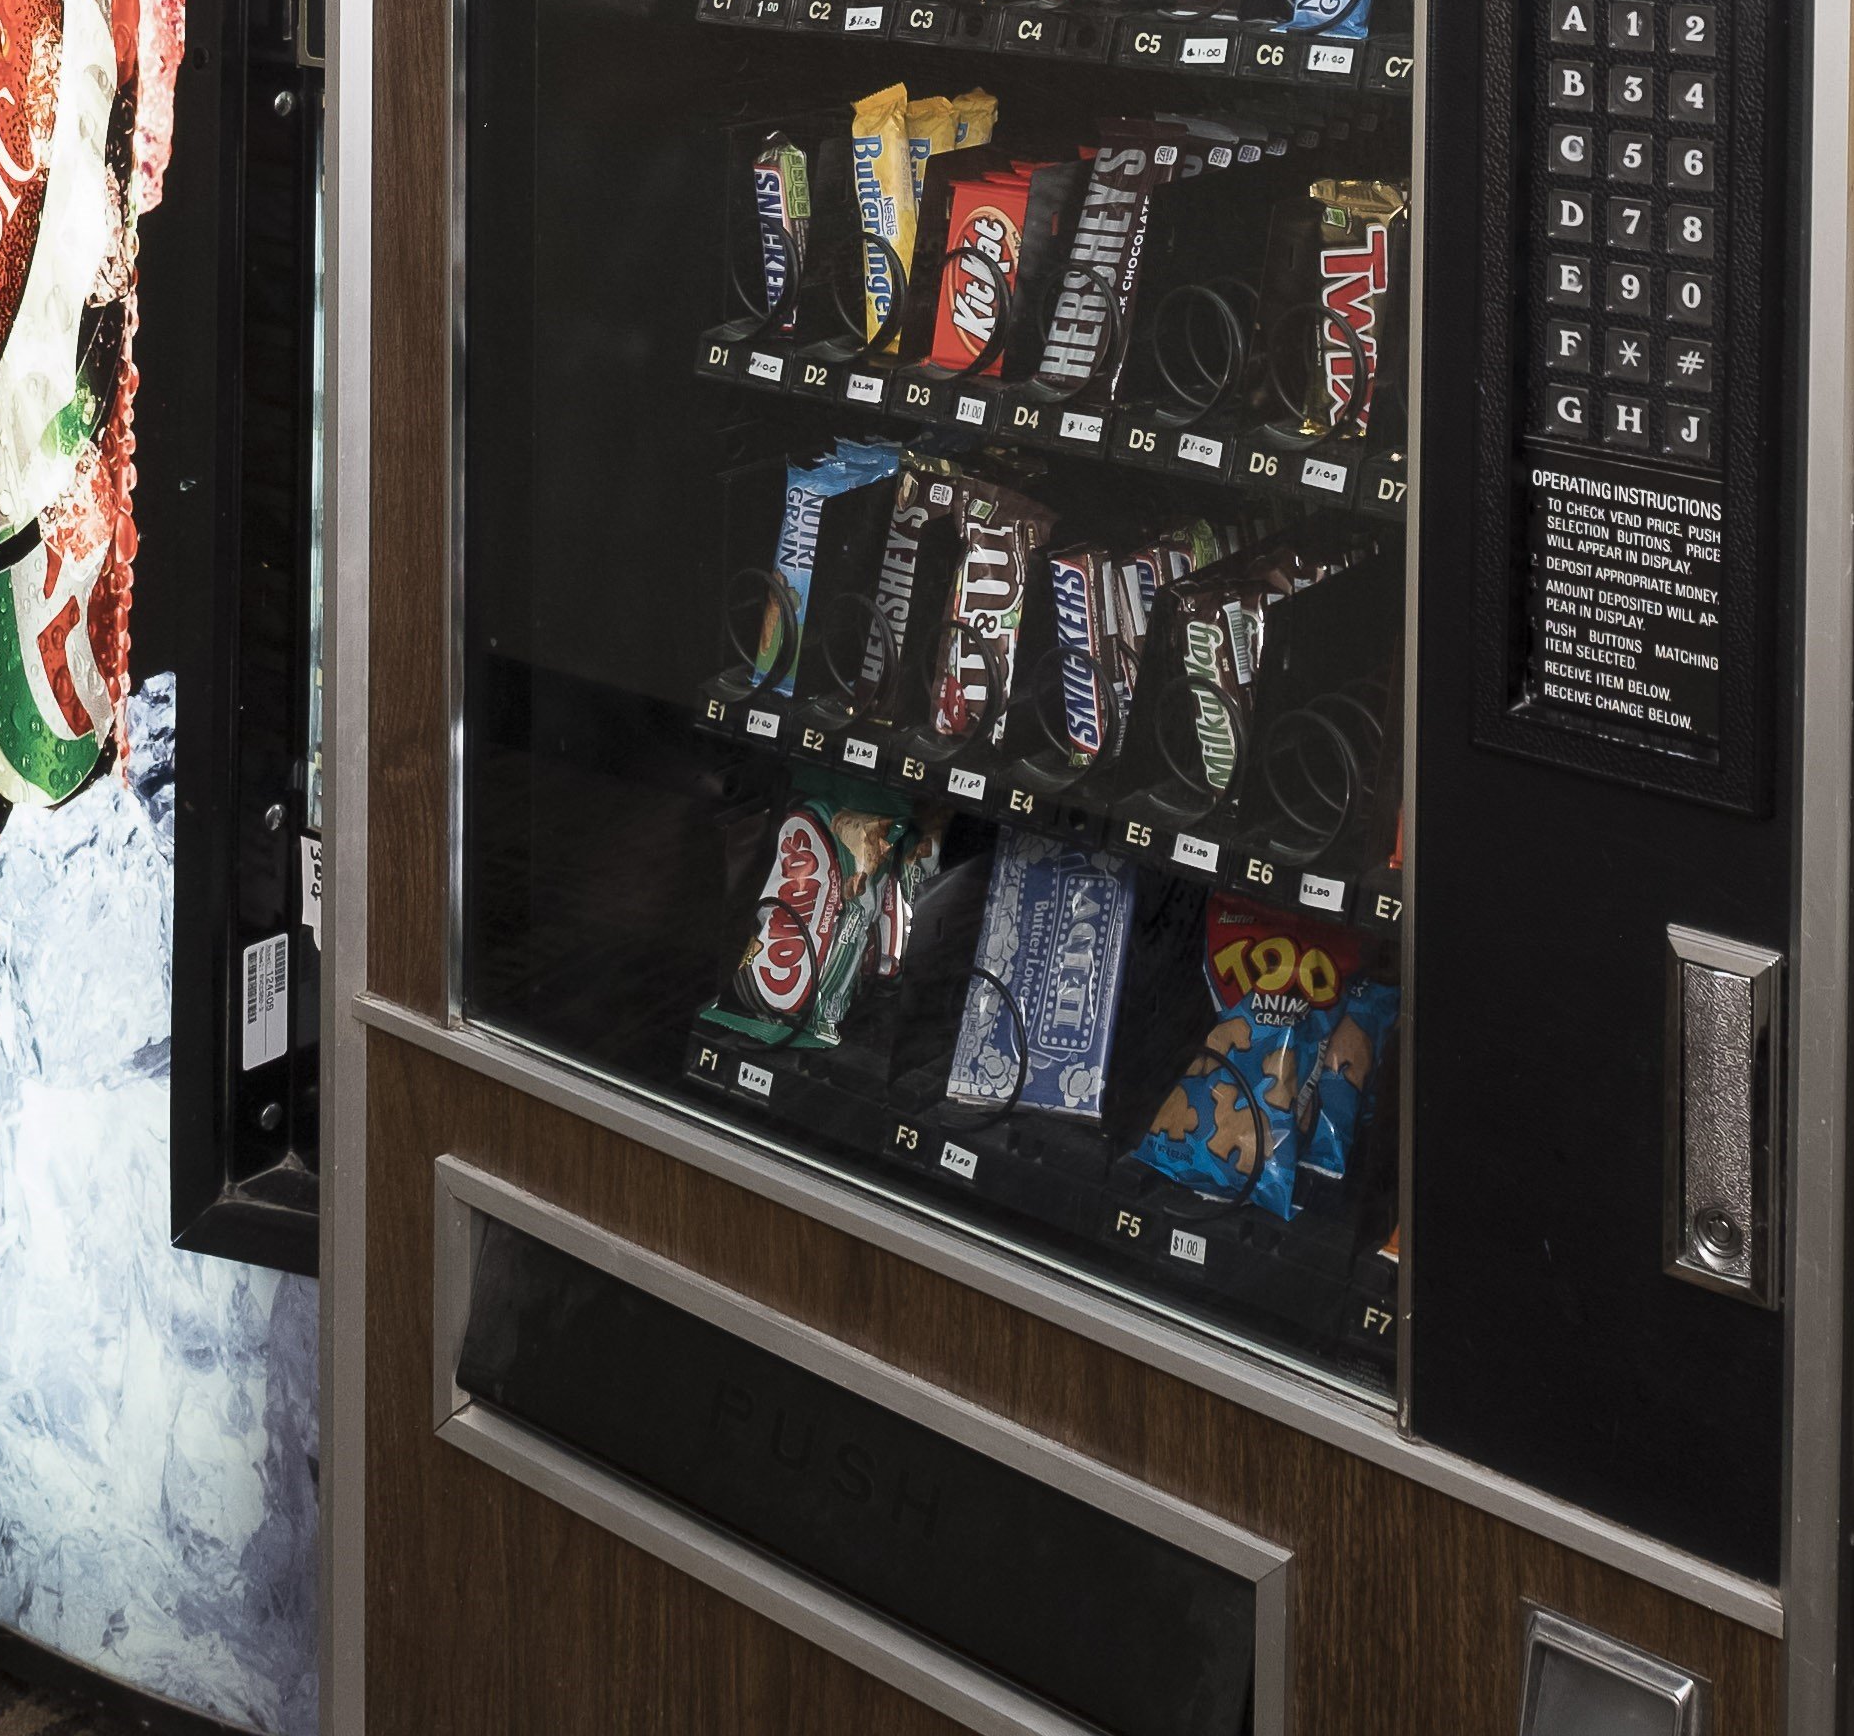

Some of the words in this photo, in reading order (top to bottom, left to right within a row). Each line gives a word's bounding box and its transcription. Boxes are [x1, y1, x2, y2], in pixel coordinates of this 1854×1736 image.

[757, 0, 779, 18] 1.00
[808, 1, 832, 20] C2
[910, 9, 934, 29] C3
[1561, 5, 1587, 33] A
[1627, 11, 1641, 37] 1
[1685, 16, 1705, 41] 2
[1017, 20, 1043, 41] C4
[1134, 32, 1162, 54] C5
[1256, 44, 1284, 66] C6
[1385, 56, 1414, 78] C7
[1562, 69, 1585, 97] B
[1623, 76, 1643, 102] 3
[1685, 82, 1704, 109] 4
[1560, 134, 1584, 162] C
[1623, 143, 1642, 169] 5
[1684, 149, 1704, 176] 6
[1560, 200, 1584, 226] D
[1623, 209, 1641, 235] 7
[1682, 216, 1703, 243] 8
[1038, 147, 1147, 379] HERSHEY'S
[1559, 265, 1583, 293] E
[1621, 274, 1640, 300] 9
[1682, 282, 1701, 309] 0
[709, 346, 730, 366] D1
[1559, 330, 1582, 357] F
[803, 364, 828, 386] D2
[906, 385, 931, 406] D3
[959, 402, 982, 420] $1.00
[1013, 406, 1039, 429] D4
[1557, 396, 1582, 424] G
[1616, 405, 1642, 434] H
[1681, 416, 1700, 443] J
[1128, 428, 1157, 452] D5
[1249, 452, 1278, 476] D6
[1377, 478, 1408, 504] D7
[1532, 469, 1611, 499] OPERATING
[1615, 485, 1722, 521] INSTRUCTIONS
[1547, 497, 1561, 512] TO
[1567, 501, 1605, 521] CHECK
[1610, 510, 1641, 527] VEND
[1688, 525, 1721, 544] PUSH
[1547, 516, 1609, 540] SELECTION
[1617, 530, 1672, 553] BUTTONS.
[1687, 544, 1721, 562] PRICE
[1547, 535, 1573, 551] WILL
[1577, 540, 1622, 560] APPEAR
[1626, 550, 1637, 563] IN
[1642, 553, 1692, 575] DISPLAY.
[1547, 556, 1592, 577] DEPOSIT
[1595, 567, 1672, 595] APPROPRIATE
[1546, 580, 1595, 601] AMOUNT
[1598, 590, 1662, 616] DEPOSITED
[1666, 605, 1696, 623] WILL
[1546, 598, 1575, 615] PEAR
[1580, 605, 1591, 619] IN
[1596, 609, 1645, 631] DISPLAY.
[1050, 560, 1100, 751] SNICKERS
[1545, 638, 1572, 655] ITEM
[1576, 645, 1637, 670] SELECTED.
[1546, 619, 1576, 638] PUSH
[1589, 629, 1642, 653] BUTTONS
[1656, 644, 1719, 670] MATCHING
[1545, 660, 1592, 683] RECEIVE
[1596, 673, 1623, 690] ITEM
[1628, 680, 1671, 702] BELOW.
[706, 700, 726, 722] E1
[1545, 682, 1591, 706] RECEIVE
[1596, 695, 1644, 719] CHANGE
[1648, 708, 1692, 730] BELOW.
[802, 727, 825, 752] E2
[902, 756, 926, 781] E3
[1009, 789, 1034, 814] E4
[1125, 821, 1153, 847] E5
[1246, 858, 1274, 885] E6
[1375, 895, 1402, 922] E7
[699, 1048, 718, 1071] F1
[895, 1124, 918, 1150] F3
[1116, 1209, 1143, 1239] F5
[1172, 1234, 1198, 1256] $1.00
[1363, 1305, 1393, 1336] F7
[708, 1378, 942, 1542] PUSH
